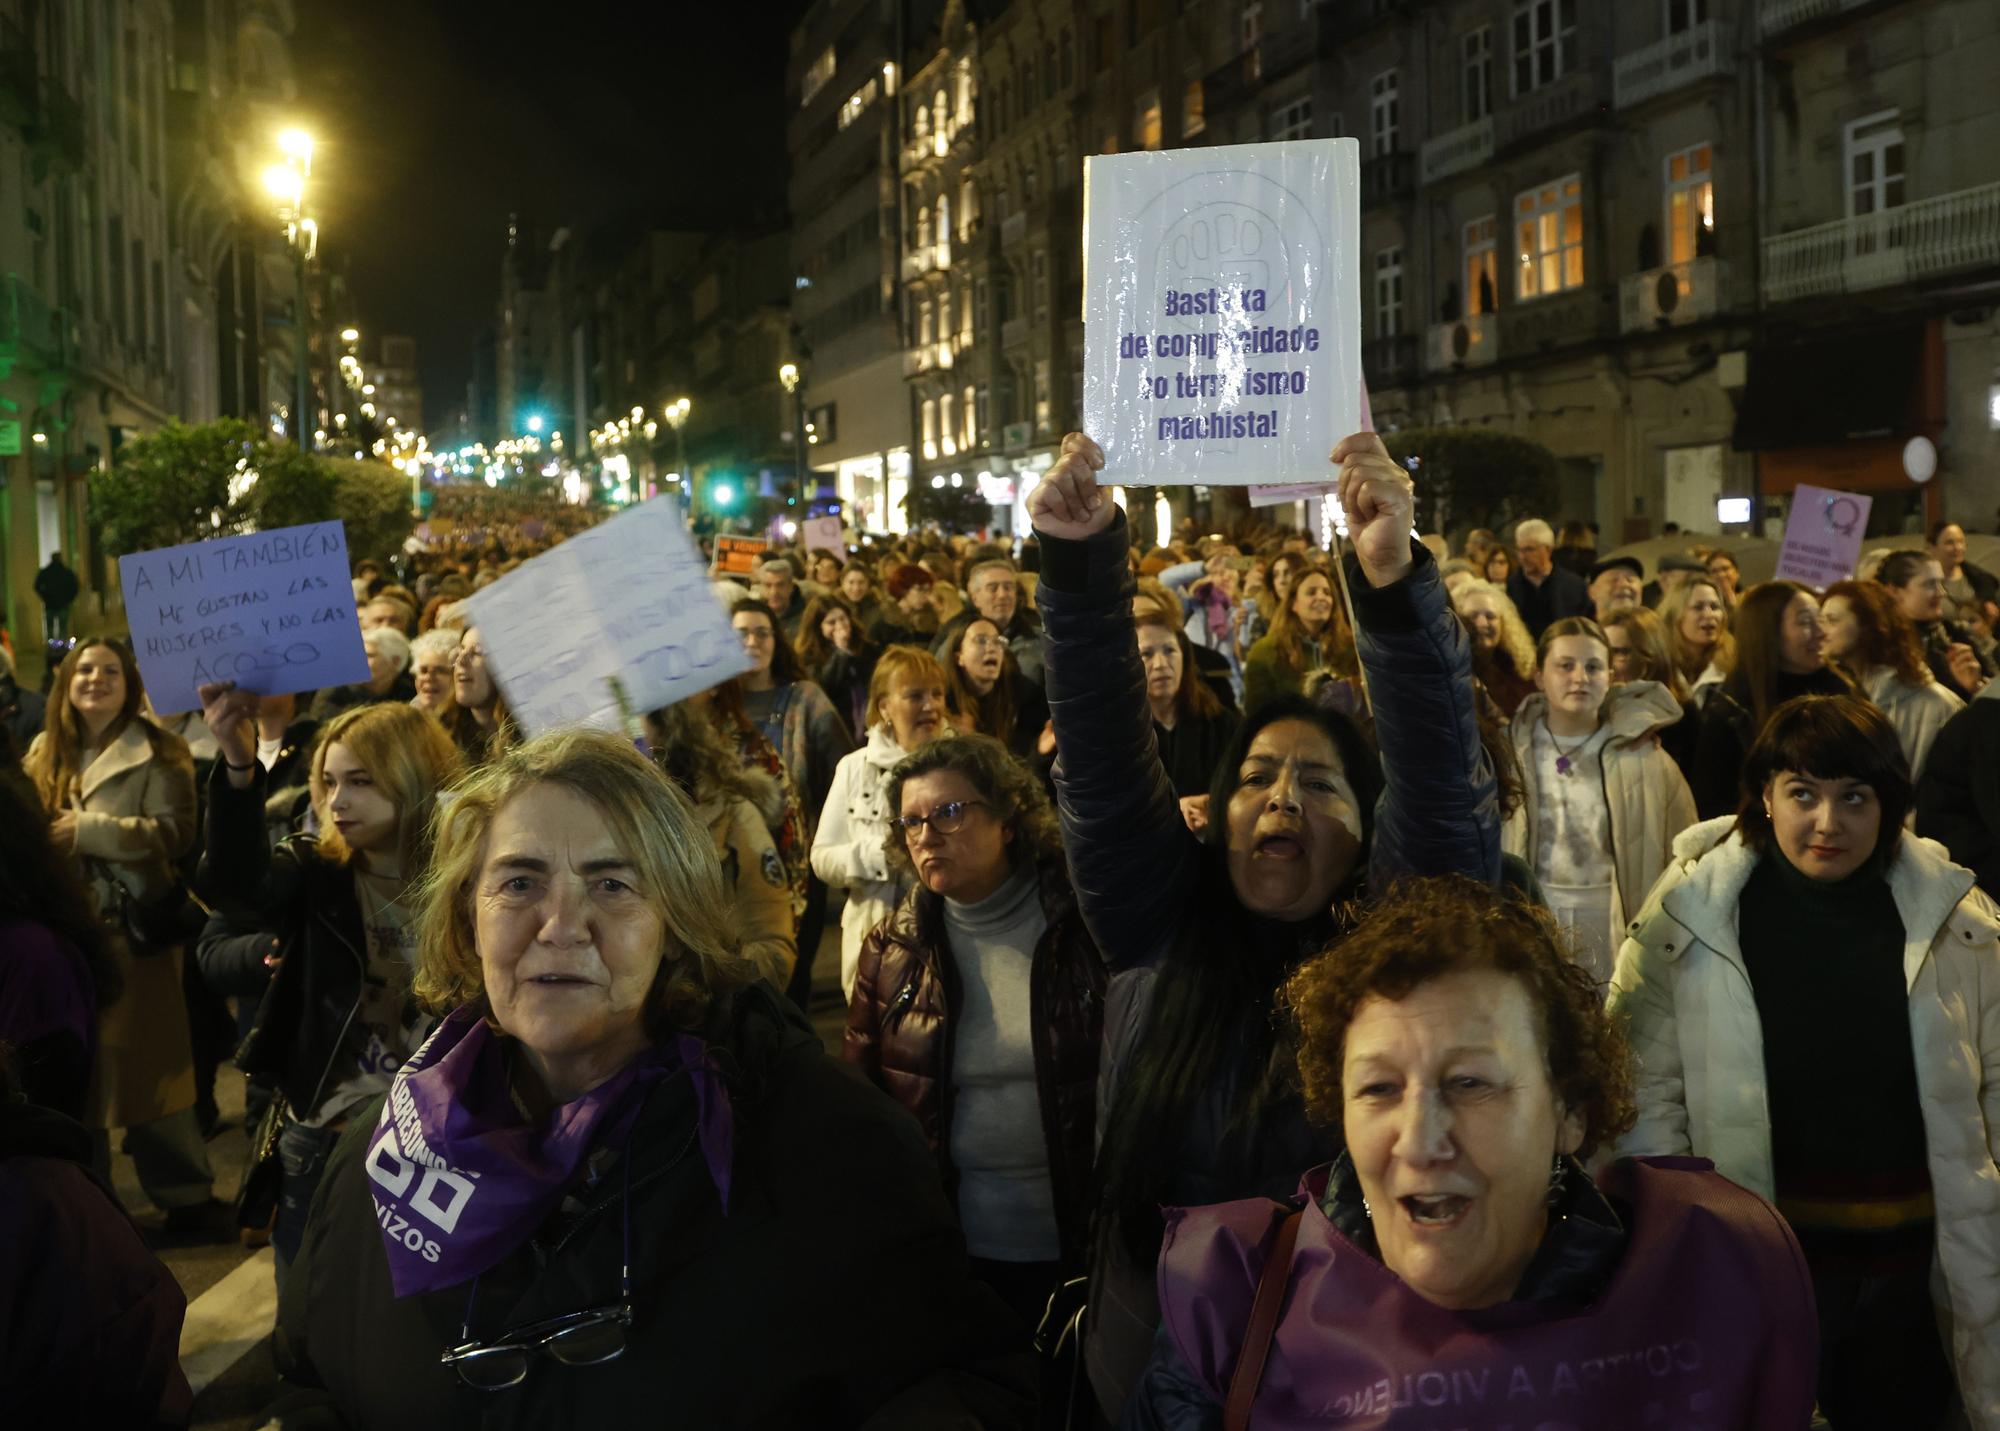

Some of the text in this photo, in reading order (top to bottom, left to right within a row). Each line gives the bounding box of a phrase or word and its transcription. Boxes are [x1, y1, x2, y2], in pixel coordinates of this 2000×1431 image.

[1120, 325, 1319, 359] de compcidade
[1176, 368, 1305, 399] terrismo
[1158, 410, 1278, 441] machista!
[134, 526, 341, 597] A MI TAMBIÉN
[158, 575, 330, 627] ME GUSTAN LAS
[145, 607, 347, 658] MUJERES Y NO LAS
[191, 641, 322, 689] ACOSO
